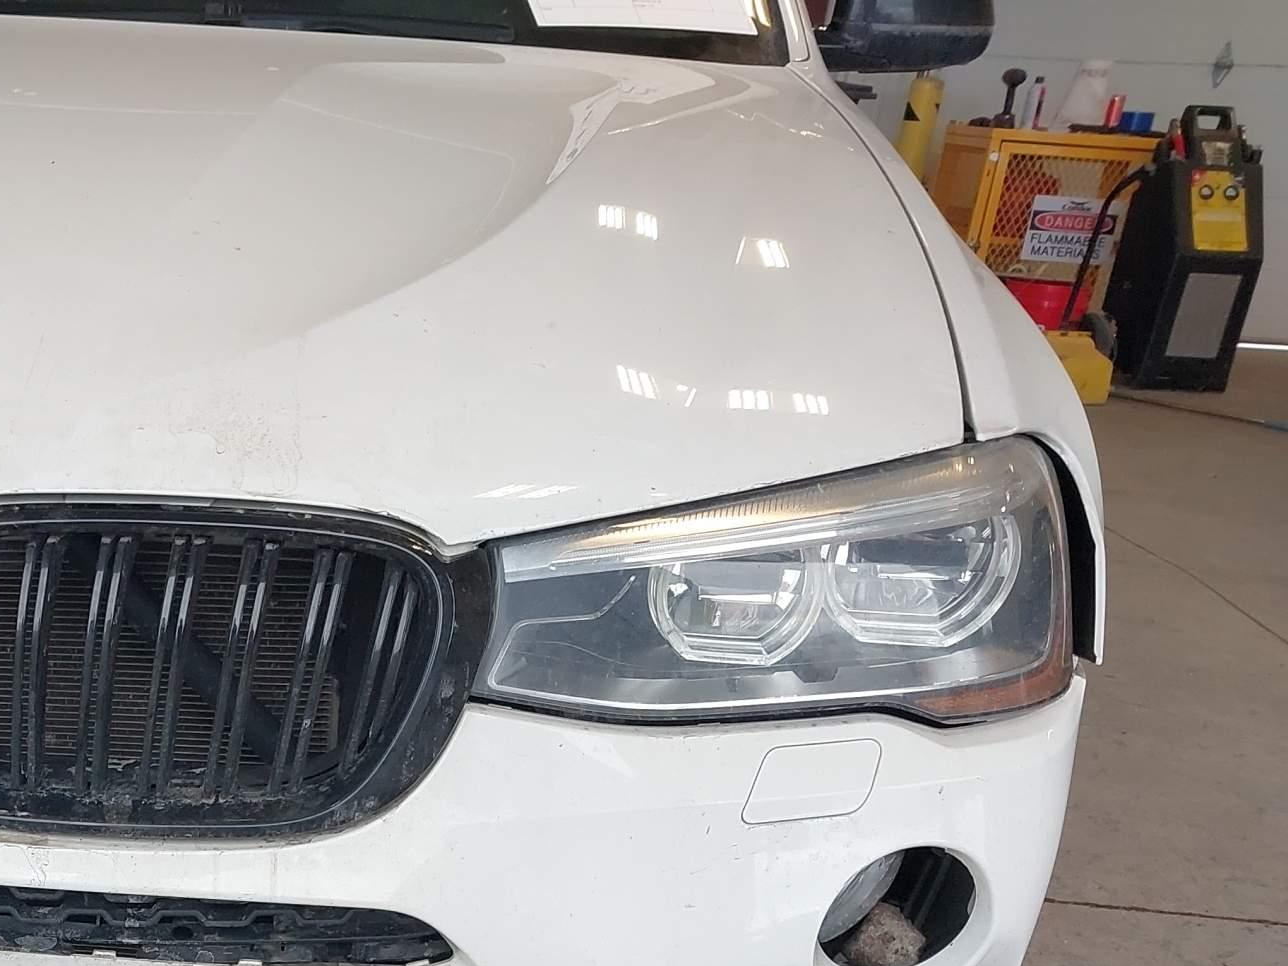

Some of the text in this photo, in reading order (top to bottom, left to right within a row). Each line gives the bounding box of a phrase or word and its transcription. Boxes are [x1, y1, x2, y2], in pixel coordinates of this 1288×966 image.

[1043, 215, 1097, 231] DANGE
[1030, 232, 1106, 249] FLAMMABE
[1030, 245, 1101, 260] MATERIAS
